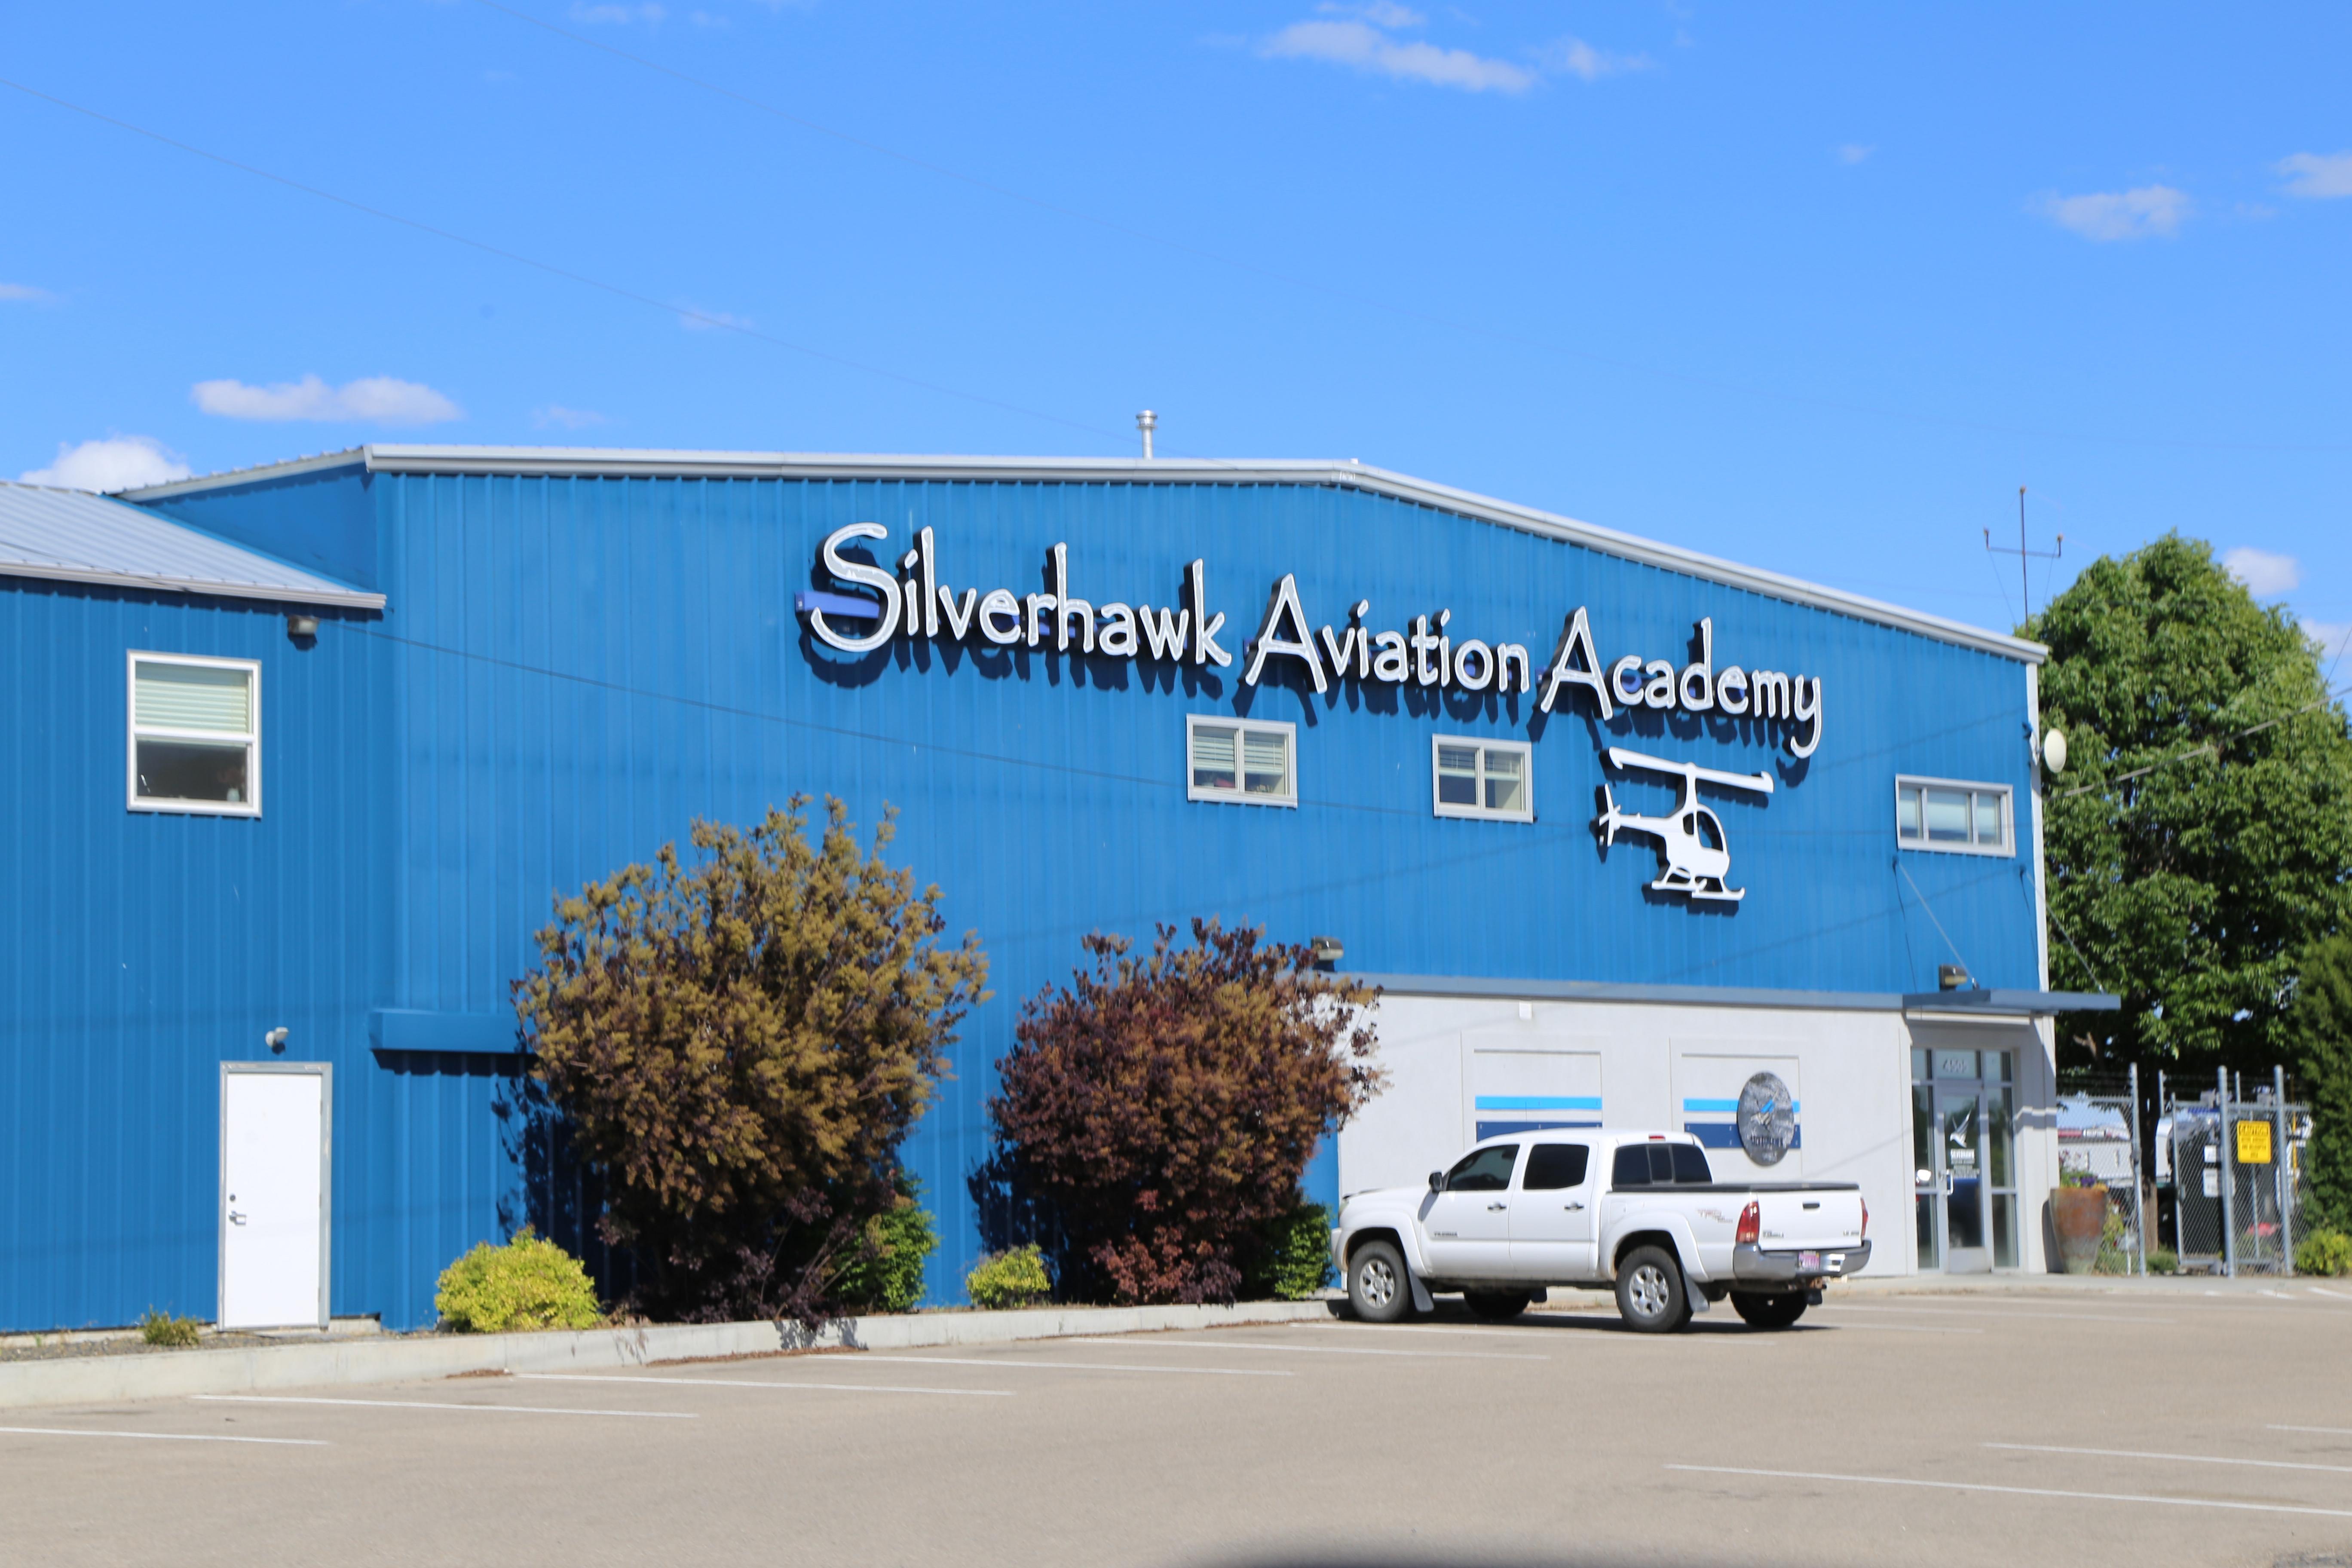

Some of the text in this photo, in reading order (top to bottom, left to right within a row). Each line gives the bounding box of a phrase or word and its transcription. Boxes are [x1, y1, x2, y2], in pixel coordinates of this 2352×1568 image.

[810, 521, 1823, 759] Silverhawk Aviation Academy
